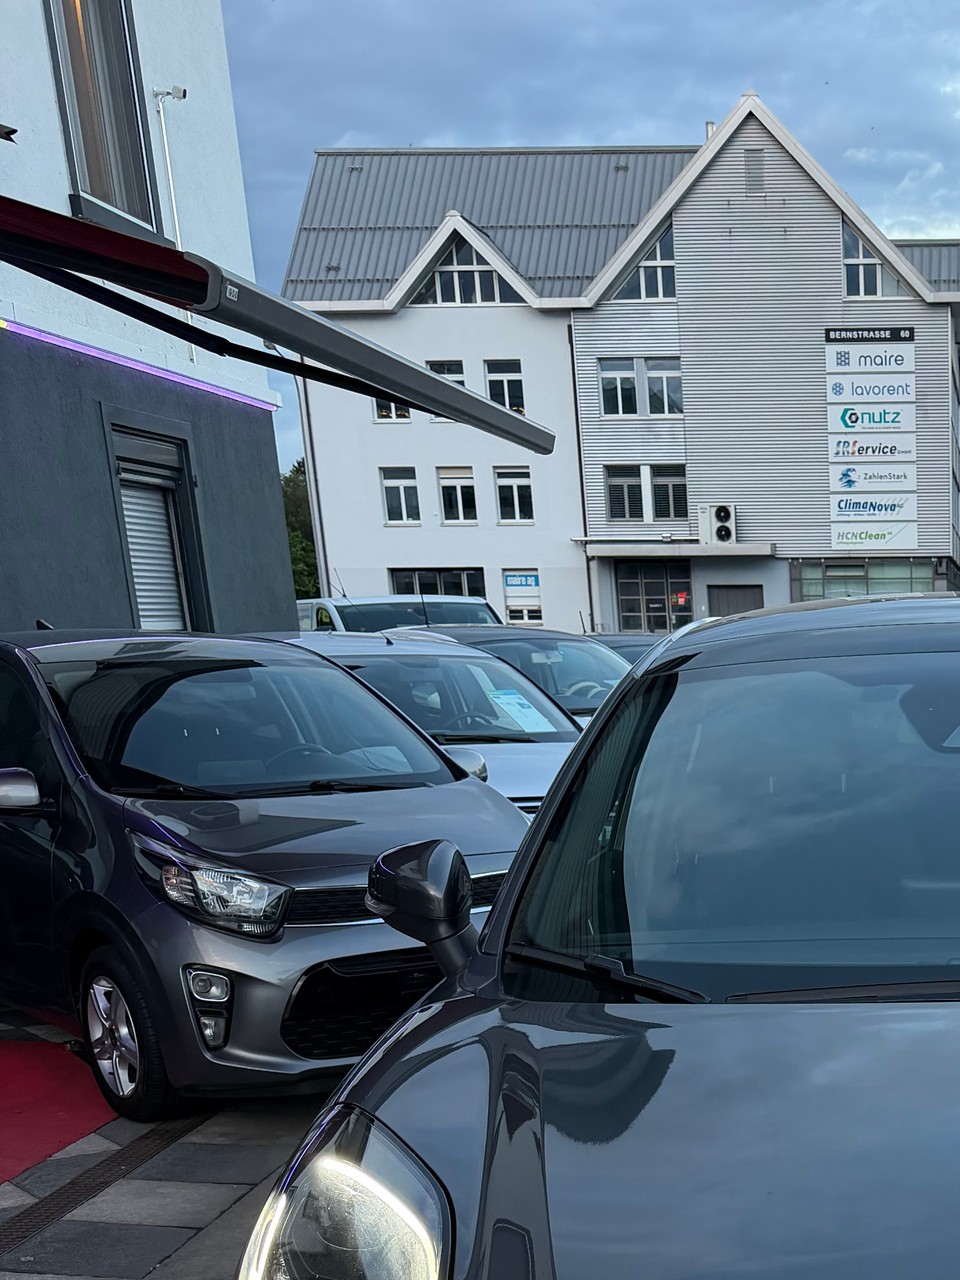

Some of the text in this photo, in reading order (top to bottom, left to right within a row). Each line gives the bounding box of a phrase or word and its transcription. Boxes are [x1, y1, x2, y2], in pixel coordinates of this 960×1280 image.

[829, 330, 910, 339] BERNSTRASSE 60
[858, 350, 905, 367] maire
[851, 381, 911, 396] lavorent
[861, 409, 901, 424] nutz
[863, 472, 908, 480] ZahlenStark
[837, 498, 897, 512] ClimaNova
[837, 531, 887, 540] HCNClean
[507, 574, 526, 585] maire
